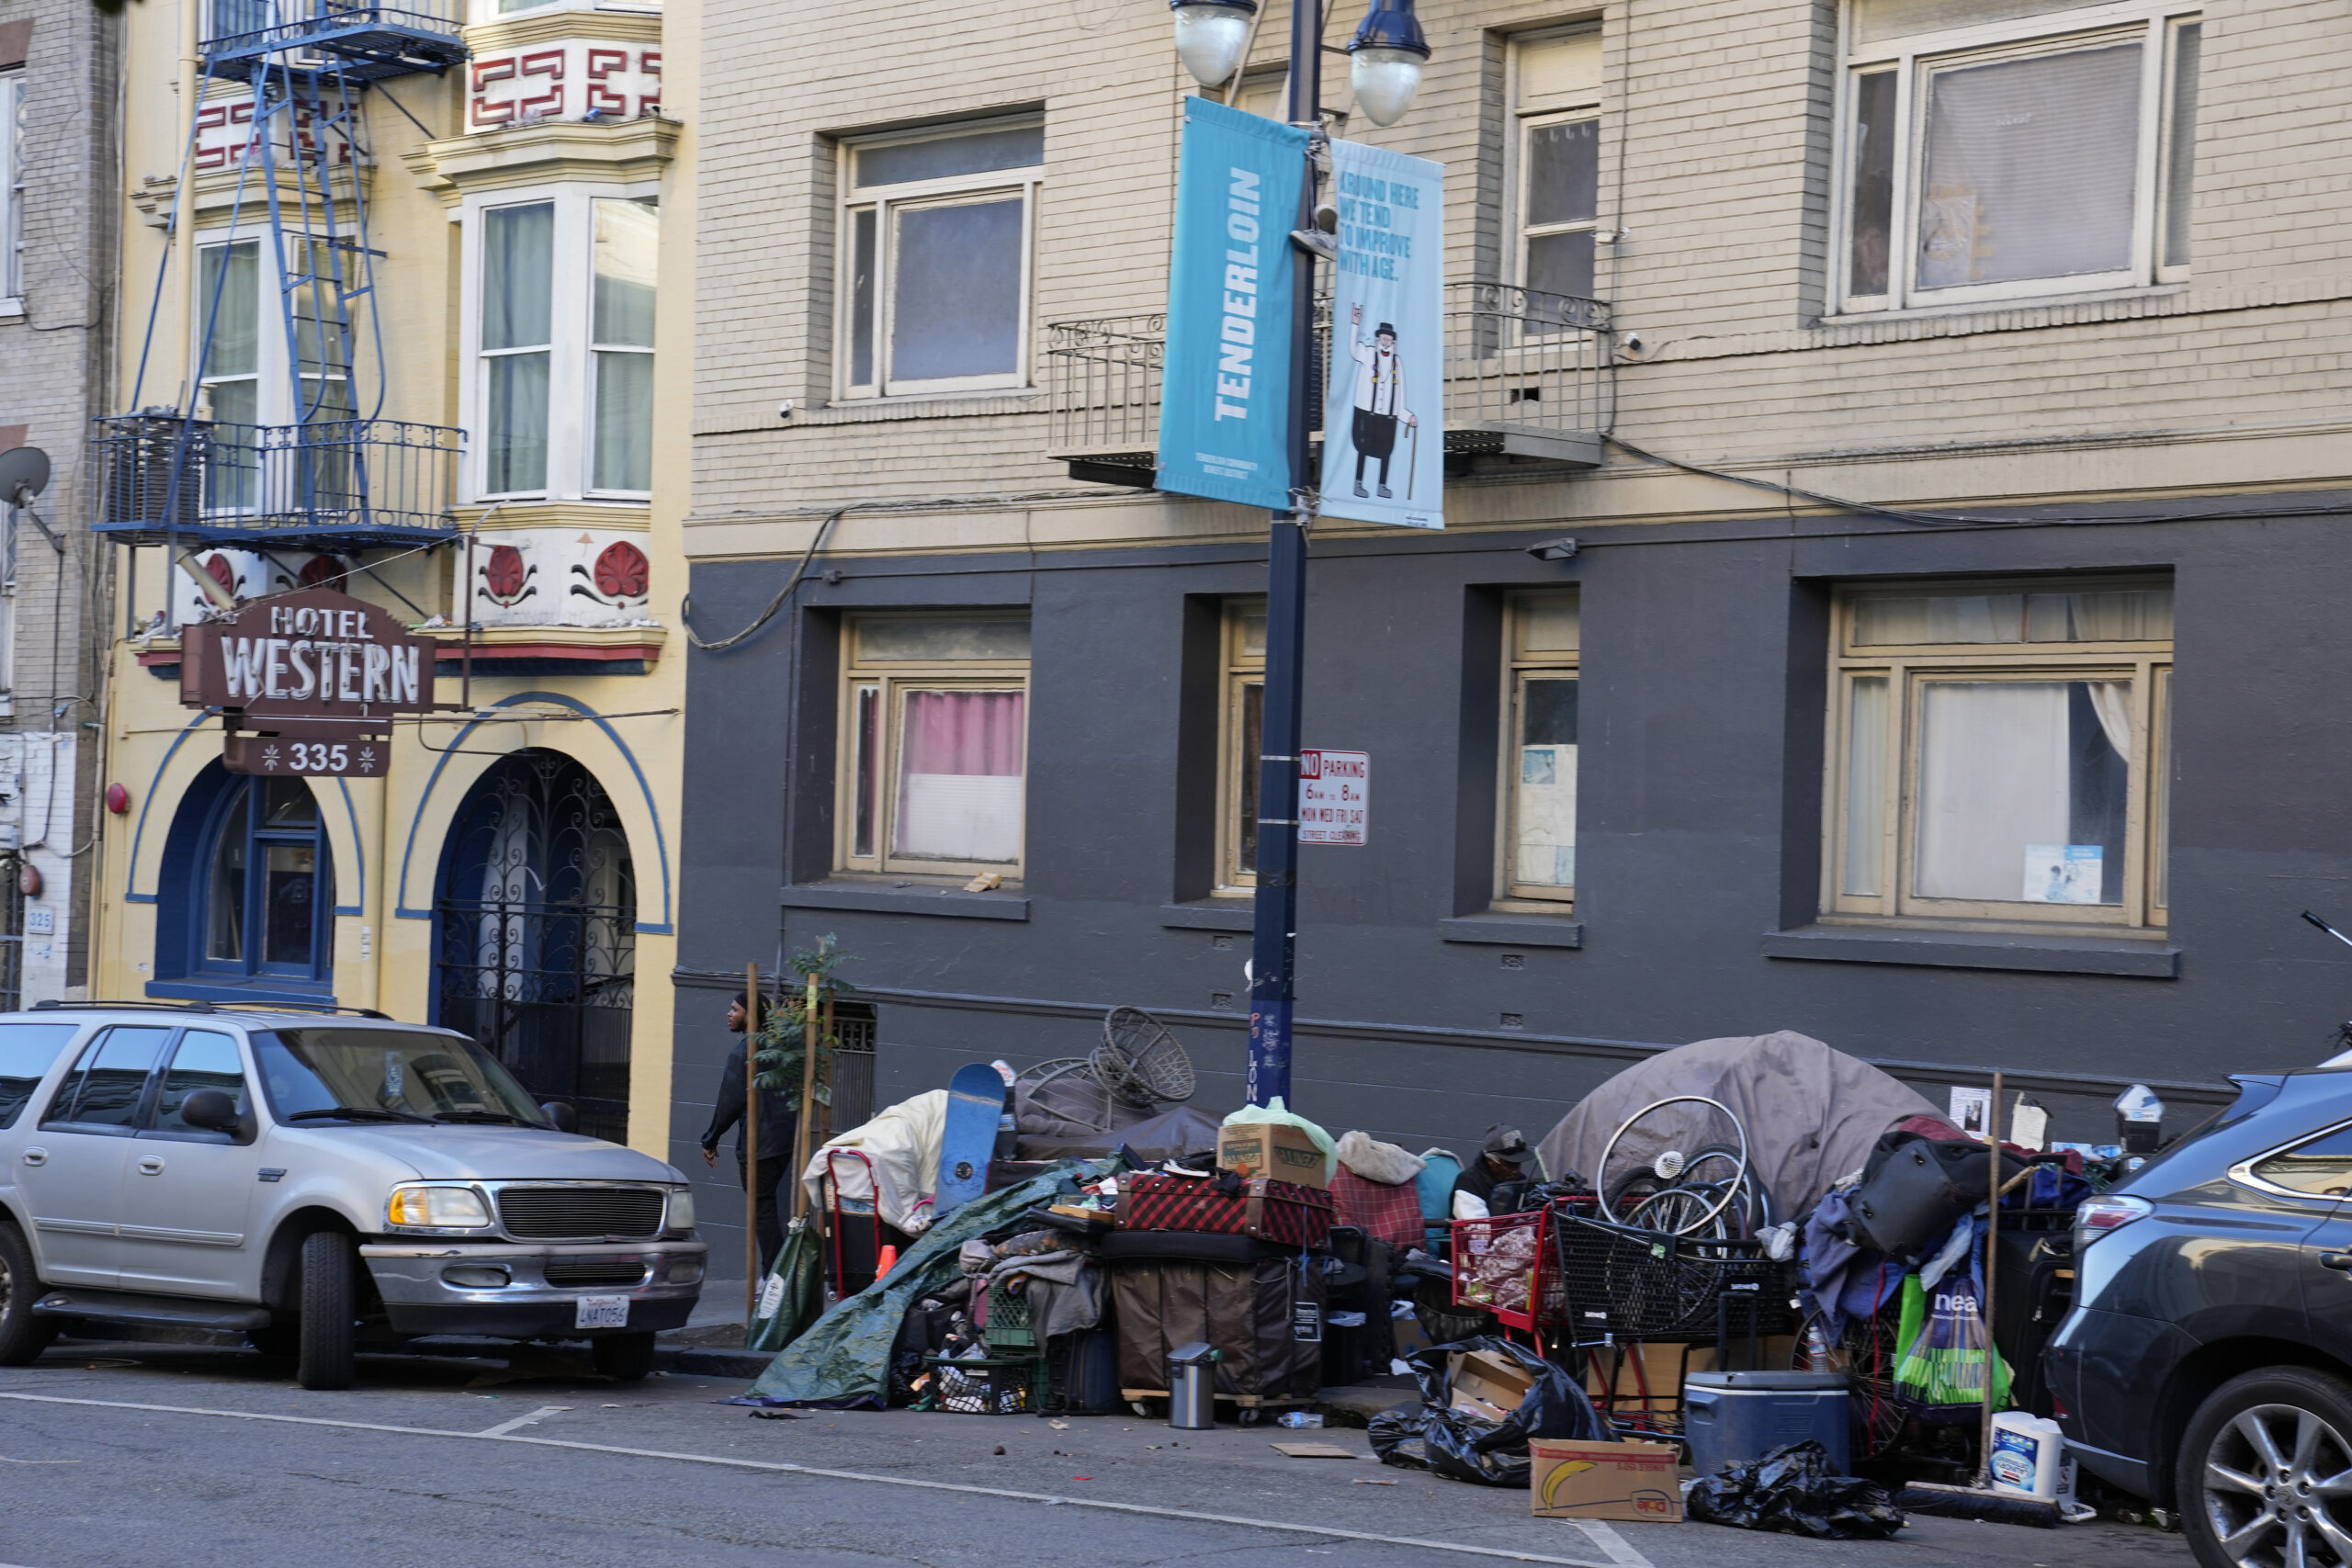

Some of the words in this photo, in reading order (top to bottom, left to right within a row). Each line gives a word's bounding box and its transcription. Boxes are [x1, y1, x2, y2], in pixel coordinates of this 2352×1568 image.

[1340, 171, 1386, 202] AROUND
[1390, 182, 1419, 209] HERE
[1339, 196, 1356, 221] WE
[1360, 200, 1390, 228] TEND
[1340, 221, 1353, 247] TO
[1355, 225, 1412, 259] IMPROVE
[1338, 246, 1368, 276] WITH
[1214, 167, 1261, 422] TENDERLOIN
[270, 606, 374, 639] HOTEL
[220, 636, 420, 705] WESTERN
[288, 742, 348, 772] 335
[1300, 753, 1319, 777] NO
[1324, 760, 1365, 779] PARKING
[1301, 807, 1317, 822] MON
[1319, 808, 1334, 823] WED
[1336, 808, 1349, 823] FRI
[1350, 809, 1363, 824] SAT
[1303, 829, 1327, 840] STREET
[30, 912, 51, 928] 325
[1636, 1499, 1667, 1513] Dole
